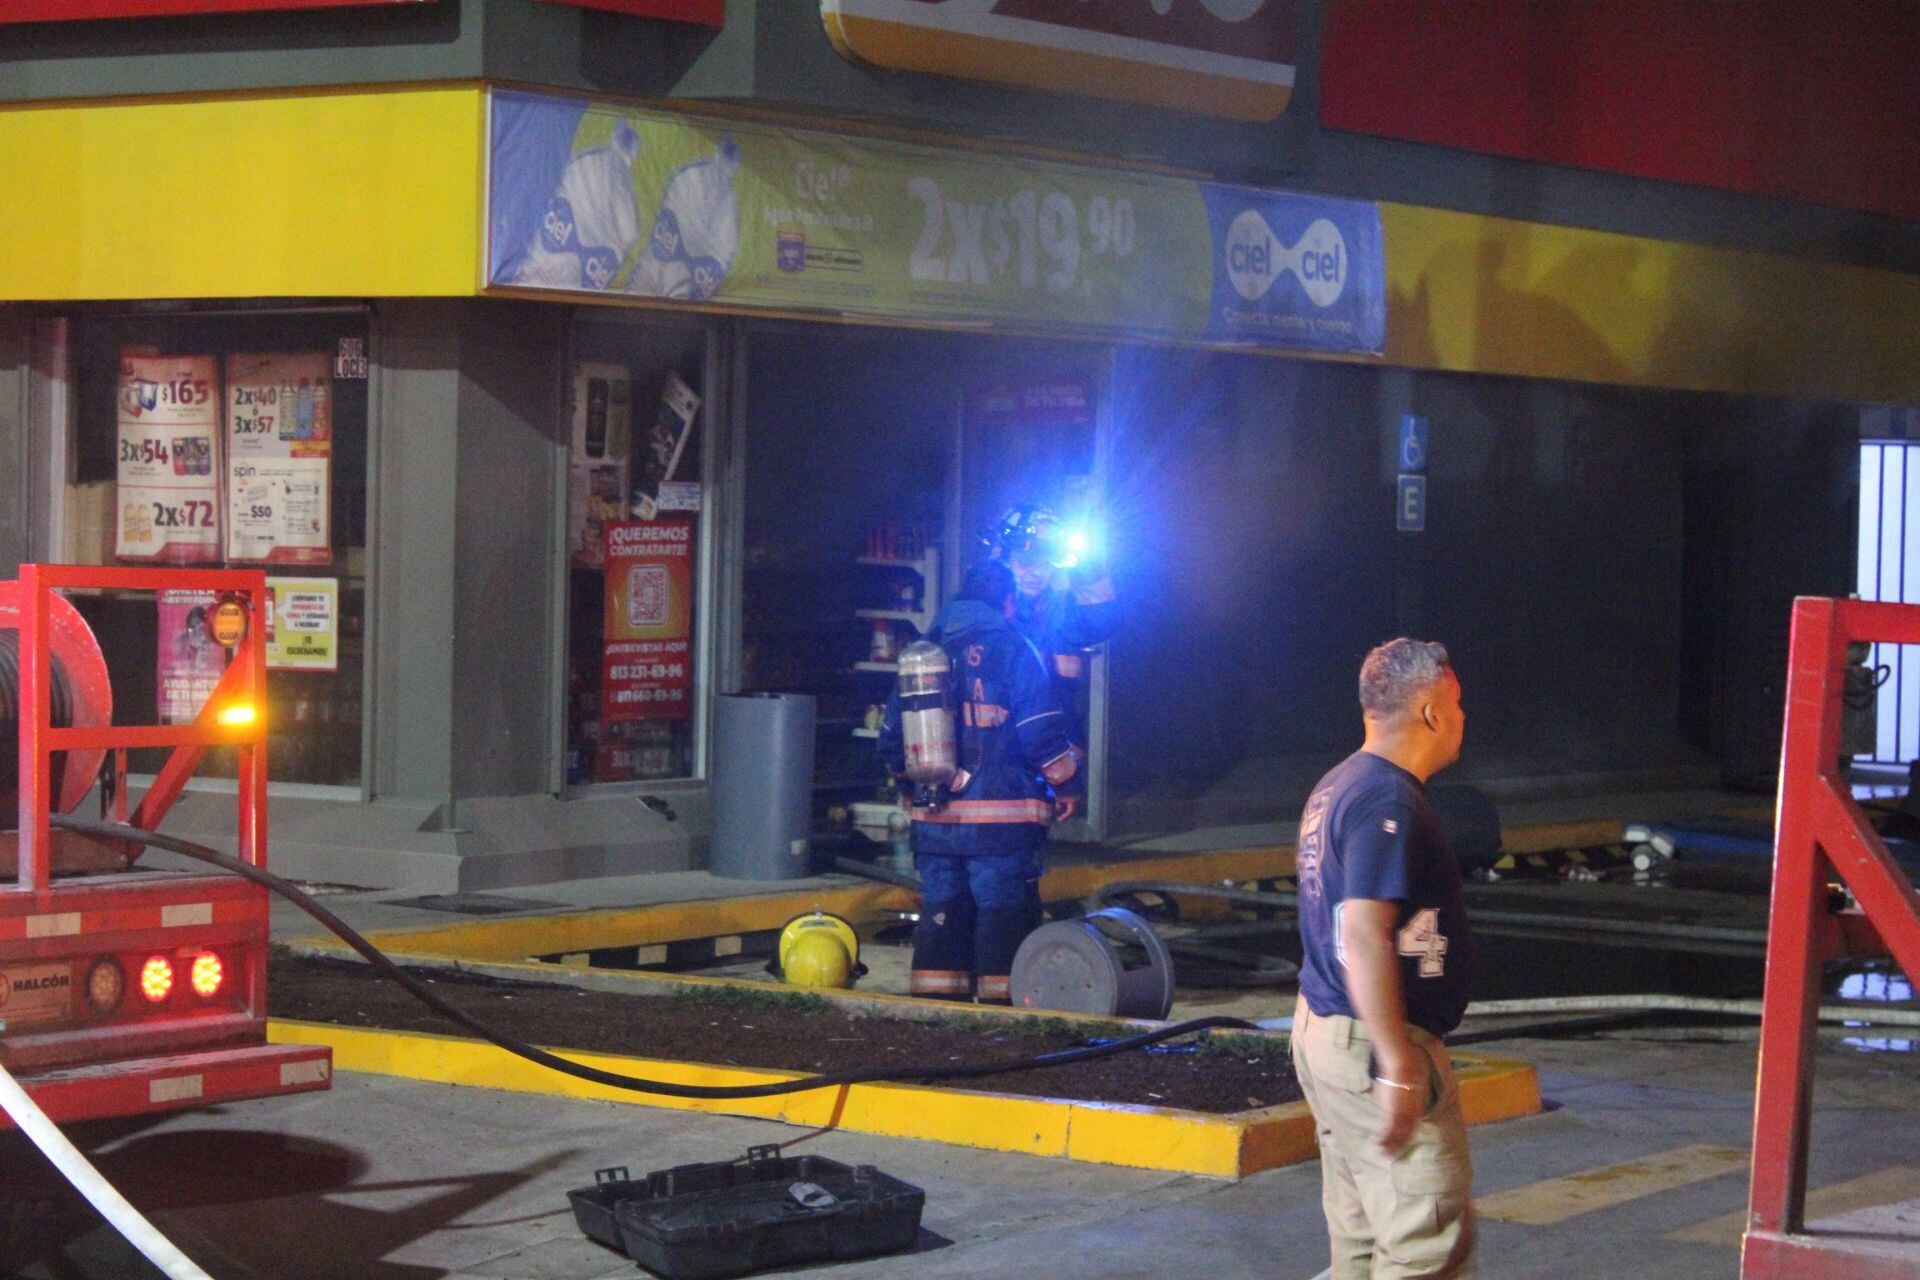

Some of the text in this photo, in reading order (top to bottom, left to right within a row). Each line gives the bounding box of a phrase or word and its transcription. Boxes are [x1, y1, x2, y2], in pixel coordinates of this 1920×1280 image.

[162, 379, 209, 405] $165
[153, 500, 214, 528] 2x$72
[250, 503, 272, 519] $50
[13, 974, 70, 992] HALCÓN
